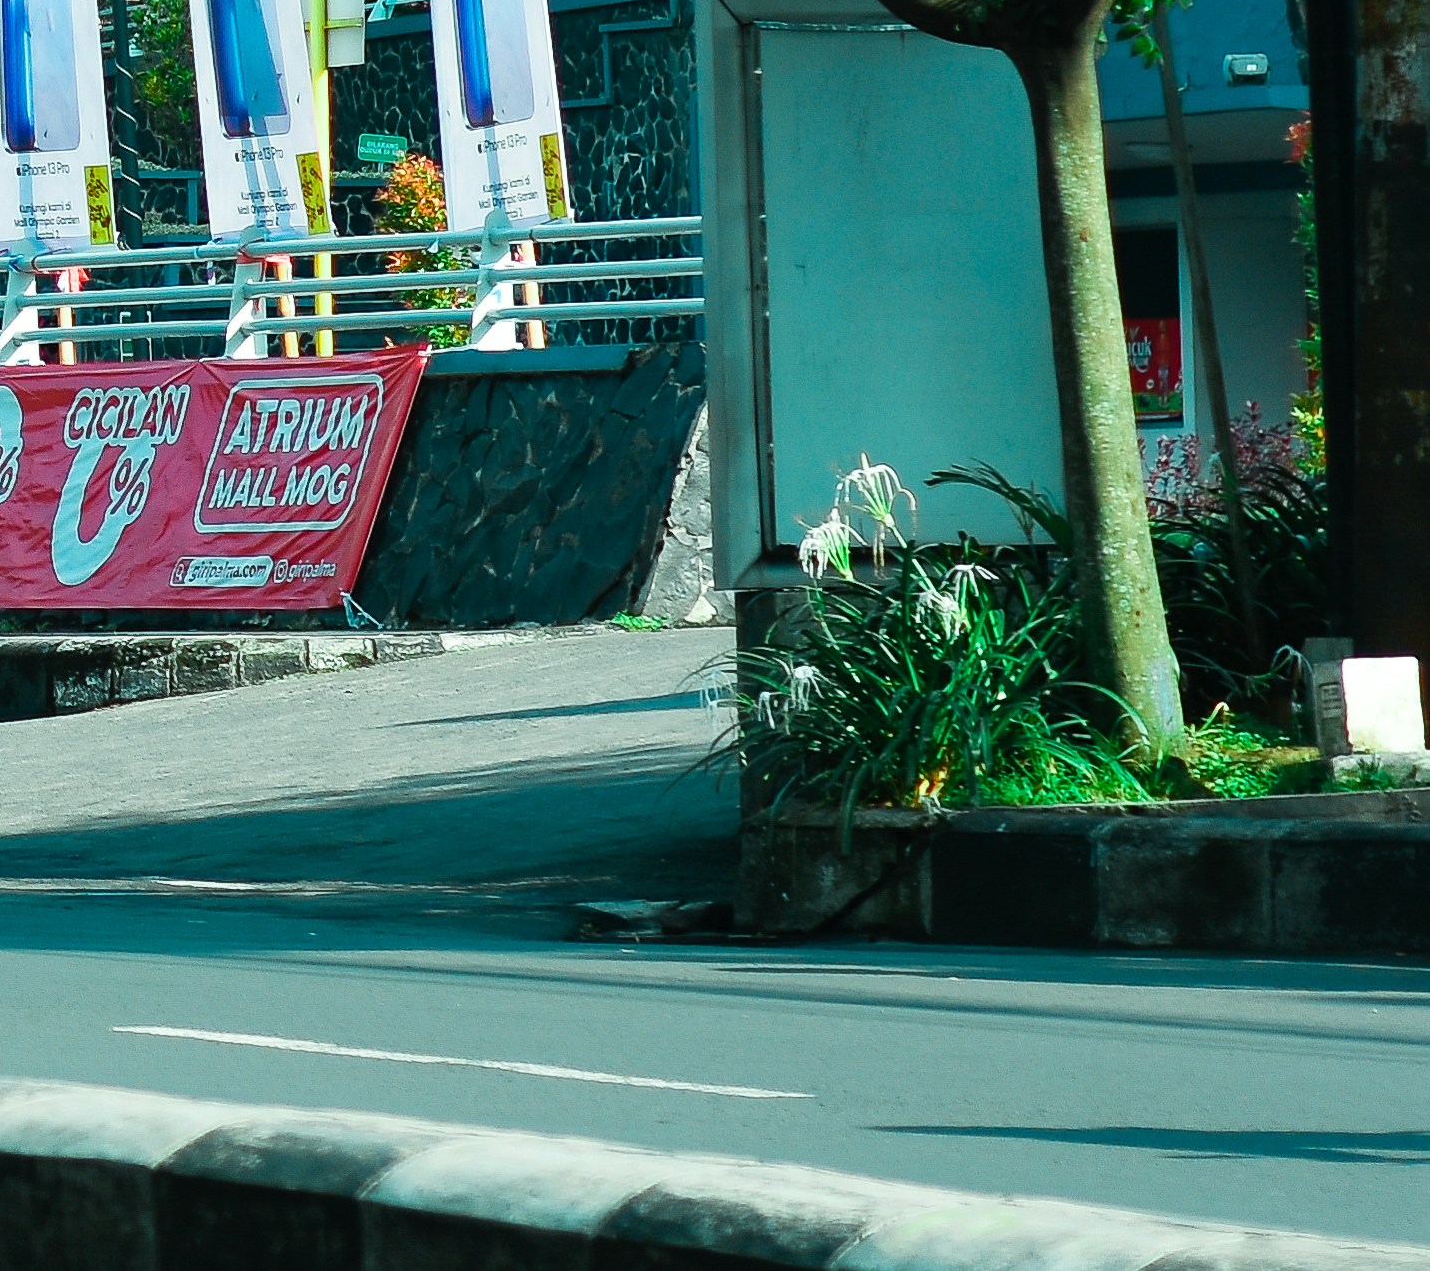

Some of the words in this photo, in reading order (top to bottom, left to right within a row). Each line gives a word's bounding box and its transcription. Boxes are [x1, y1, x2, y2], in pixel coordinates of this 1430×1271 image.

[63, 384, 192, 448] CICILAN
[223, 394, 372, 457] ATRIUM
[208, 468, 279, 510] MALL
[283, 461, 352, 508] MOG
[189, 560, 267, 583] giripalma.com
[286, 559, 337, 583] giripalma
